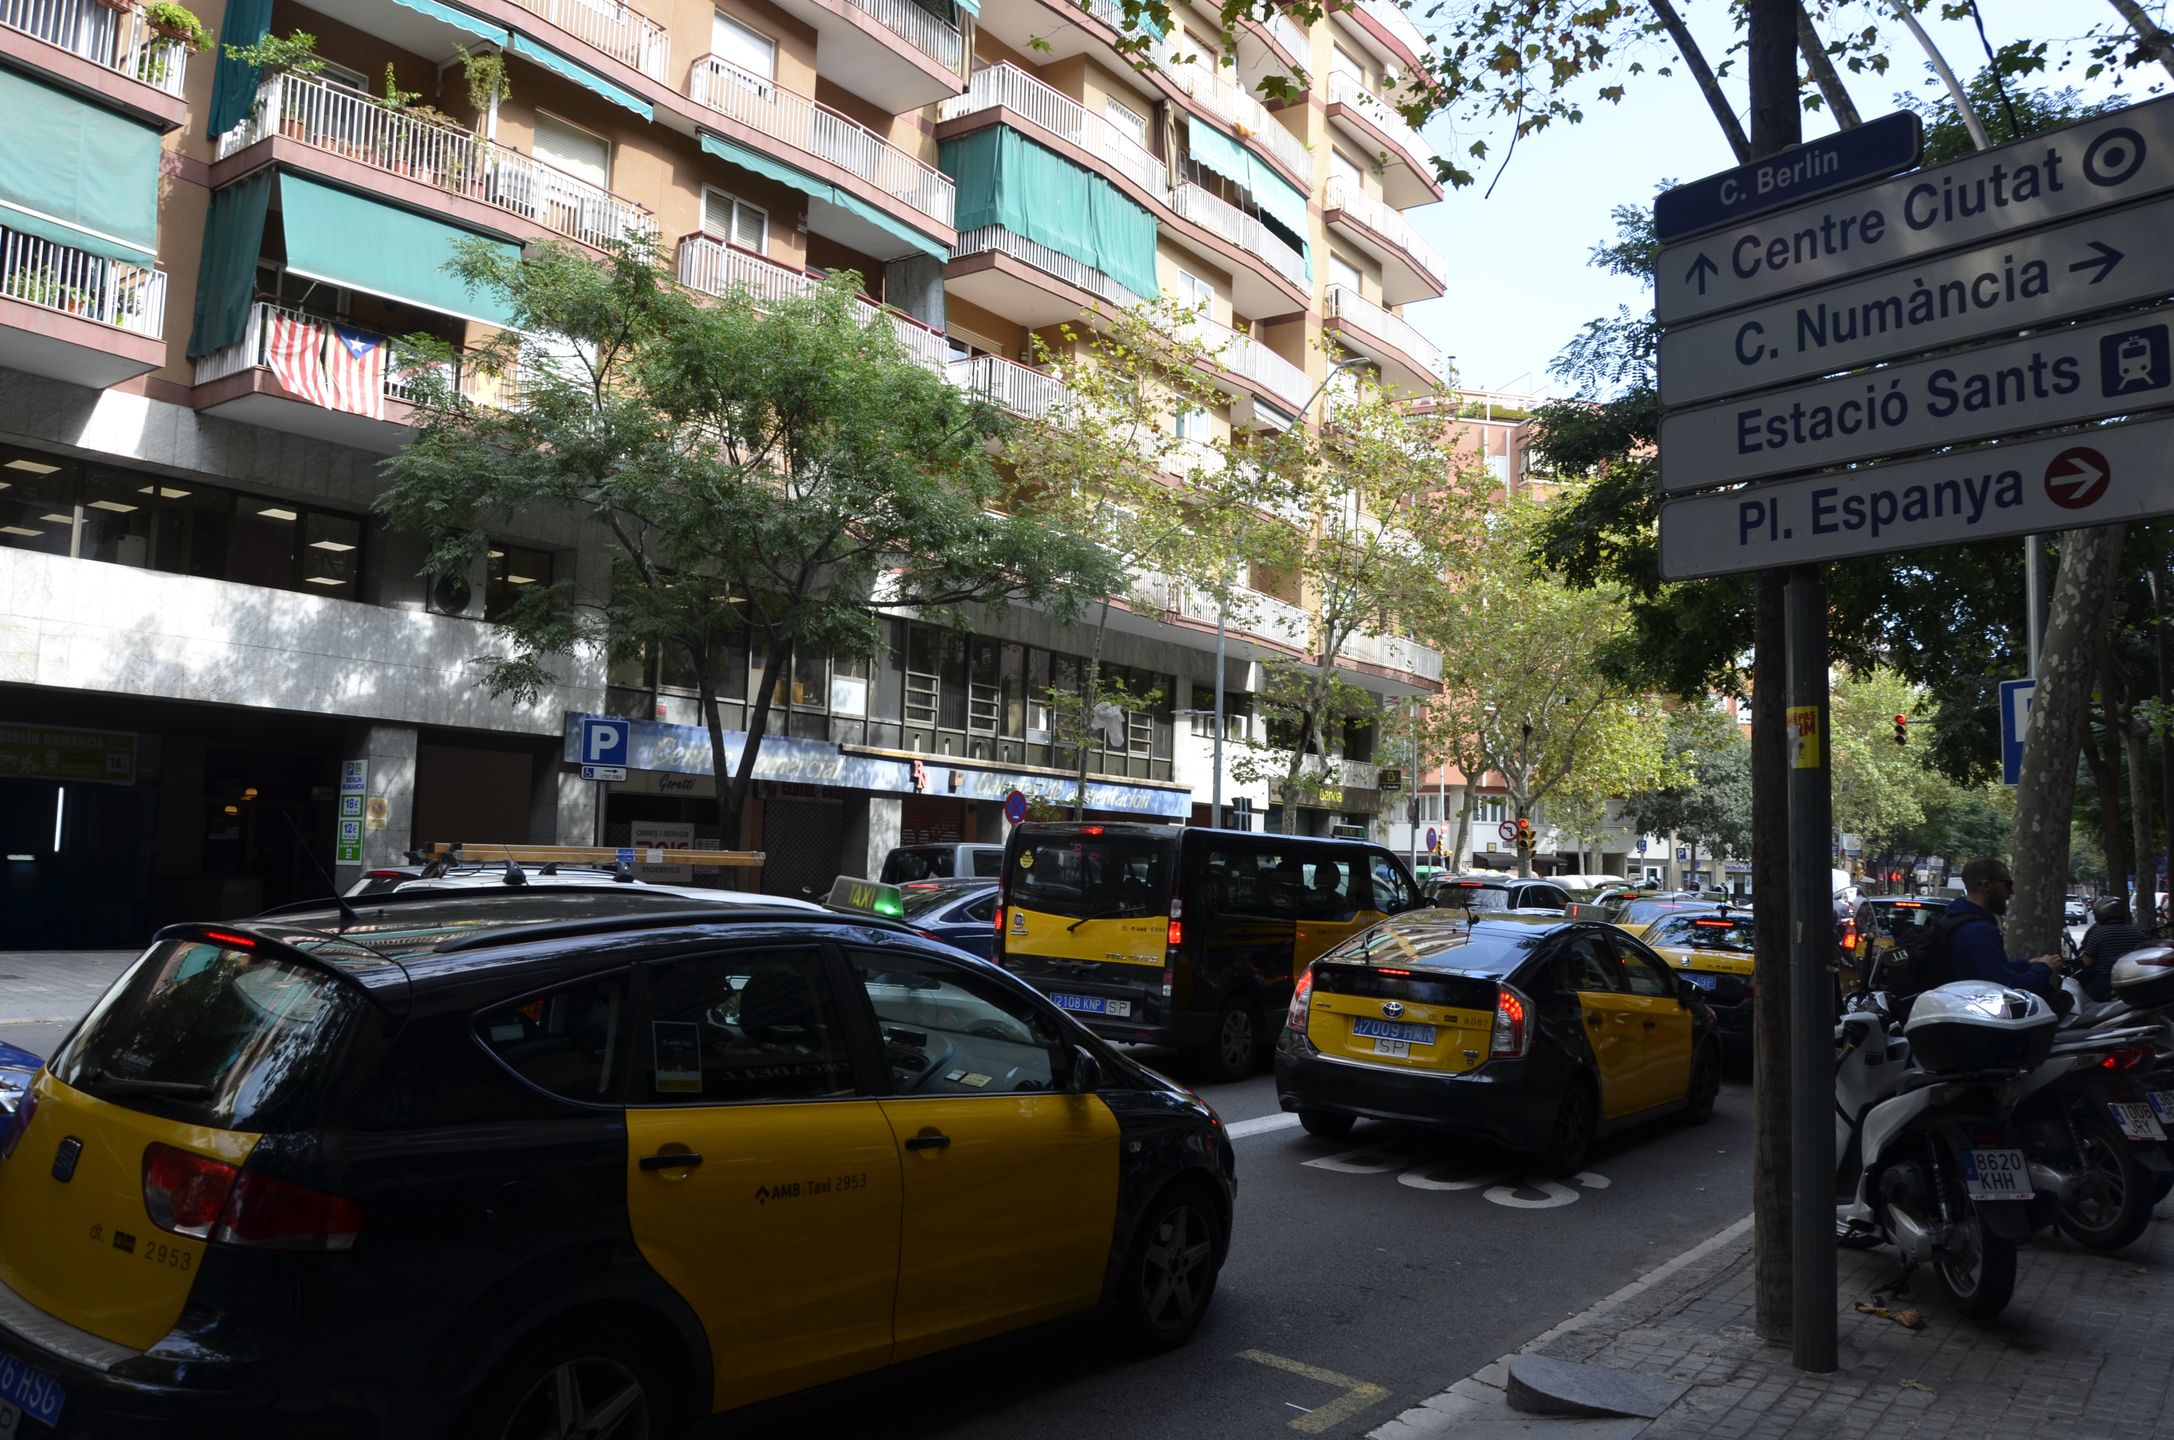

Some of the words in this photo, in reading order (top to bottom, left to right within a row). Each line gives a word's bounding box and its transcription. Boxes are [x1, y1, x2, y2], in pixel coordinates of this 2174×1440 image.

[1719, 178, 1747, 206] C.
[1757, 149, 1839, 195] Berlin
[1732, 210, 1885, 280] Centre
[1904, 148, 2064, 231] Ciutat
[1734, 320, 1780, 366] C.
[1797, 256, 2050, 353] Numància
[1736, 380, 1909, 455] Estació
[1926, 353, 2081, 419] Sants
[1739, 499, 1793, 546] Pl.
[1811, 469, 2024, 539] Espanya
[590, 725, 620, 760] P
[753, 752, 846, 779] omercial
[659, 774, 695, 791] Goretti
[1319, 788, 1343, 803] Bankia
[849, 884, 876, 909] TAXI
[1056, 995, 1081, 1009] 2108
[1083, 998, 1102, 1011] KNP
[1361, 1019, 1401, 1038] 7009
[1380, 1038, 1405, 1054] SP
[1976, 1153, 2022, 1171] 8620
[771, 1183, 801, 1201] AMB
[806, 1178, 831, 1197] Taxi
[835, 1173, 867, 1192] 2953
[1979, 1172, 2016, 1190] KHH
[145, 1240, 192, 1272] 2953
